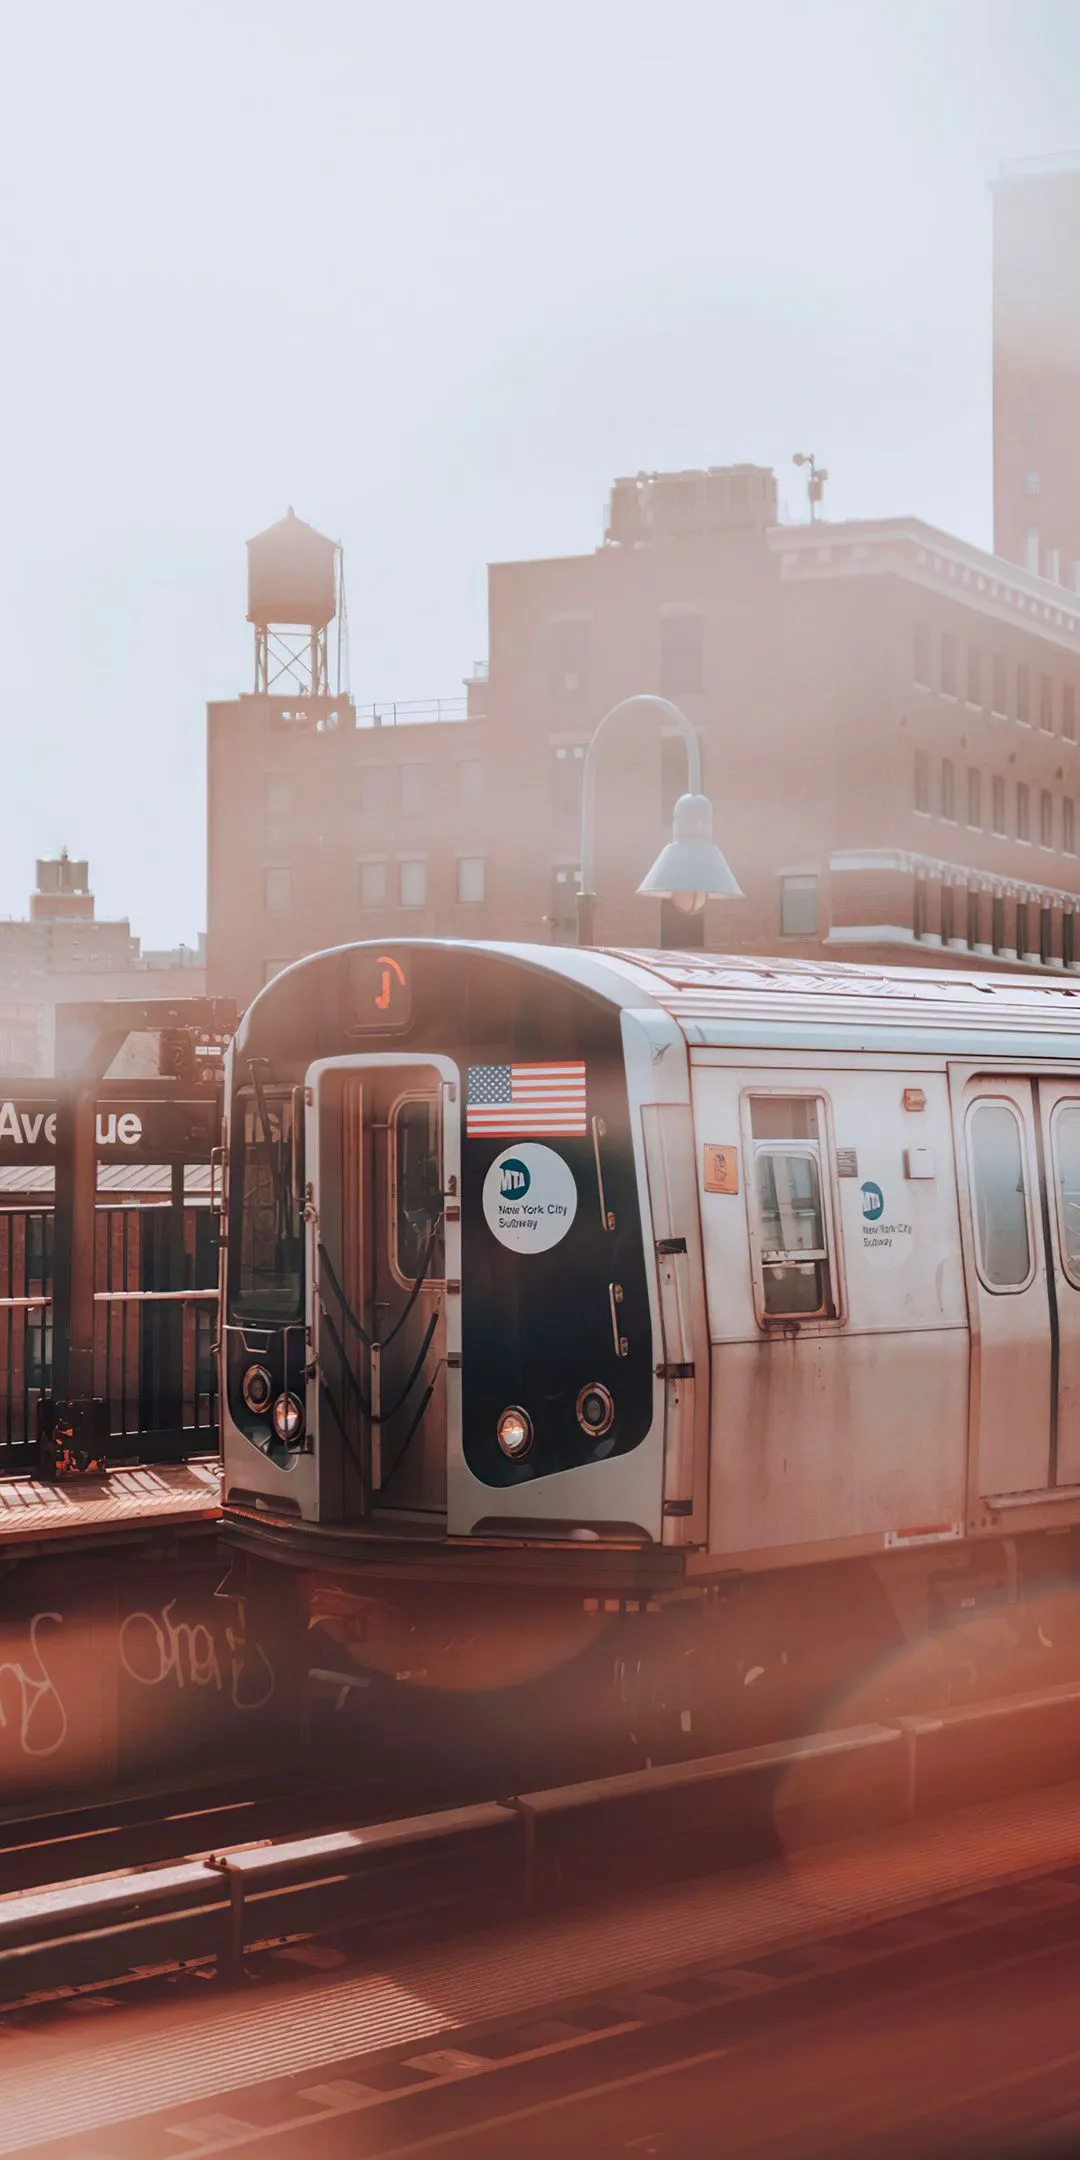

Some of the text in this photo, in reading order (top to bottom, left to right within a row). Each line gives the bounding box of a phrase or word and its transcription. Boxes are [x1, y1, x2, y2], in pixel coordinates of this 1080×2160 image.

[0, 1102, 142, 1145] Aveue
[499, 1168, 525, 1191] MTA
[499, 1204, 567, 1216] New York City
[499, 1218, 538, 1230] Subway
